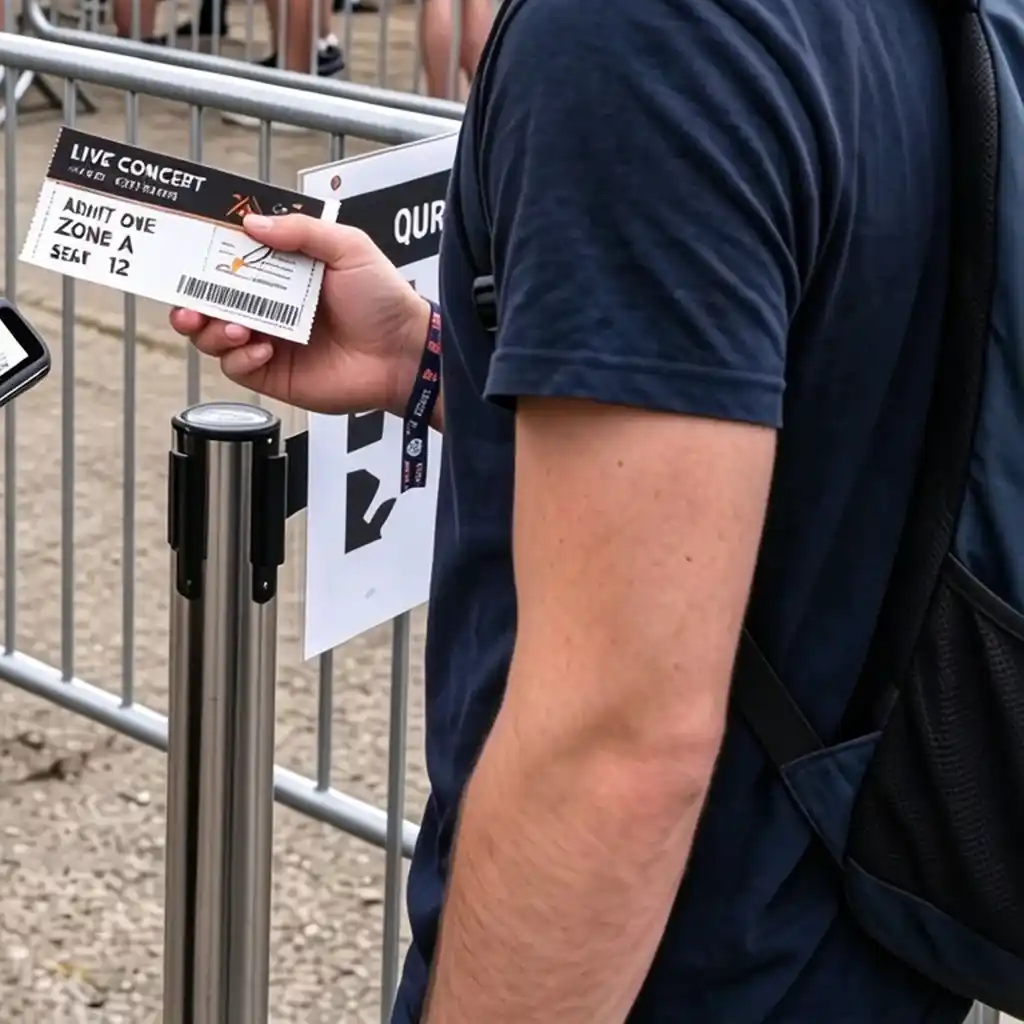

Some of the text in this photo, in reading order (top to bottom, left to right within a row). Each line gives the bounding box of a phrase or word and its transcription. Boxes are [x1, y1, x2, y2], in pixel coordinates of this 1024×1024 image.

[70, 143, 115, 168] LIVE
[54, 216, 134, 255] ZONE A
[108, 256, 131, 277] 12
